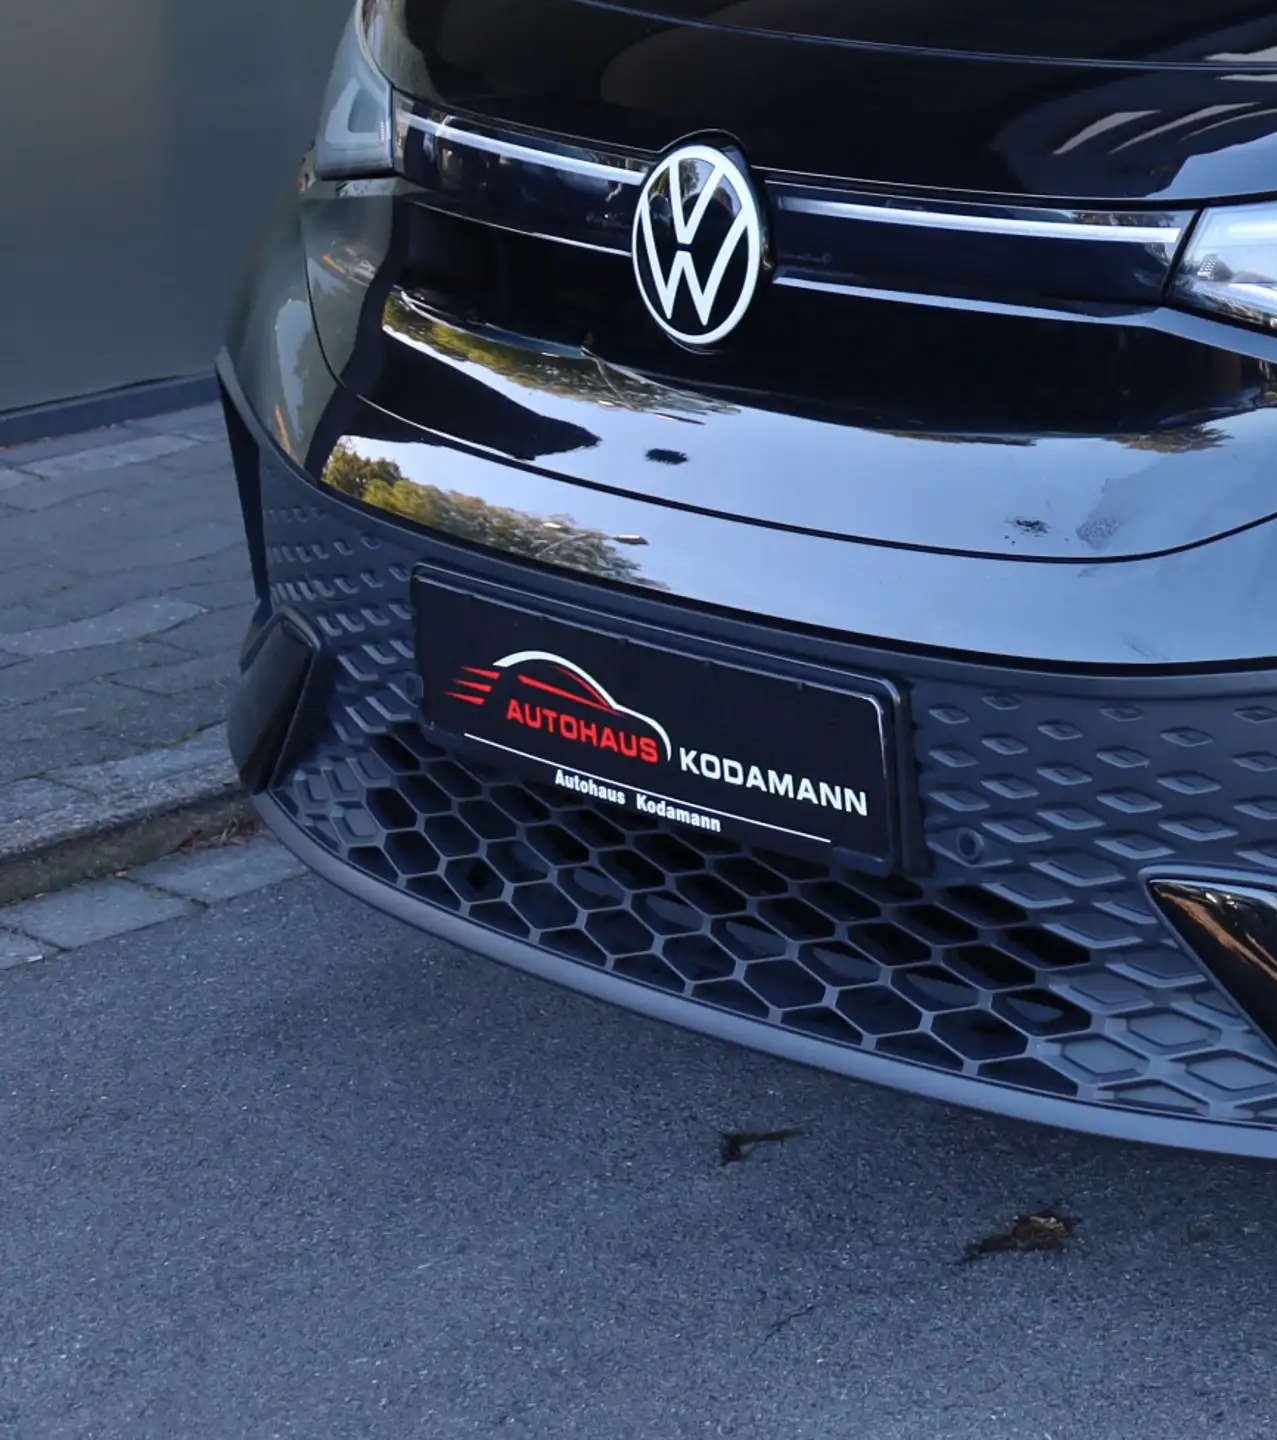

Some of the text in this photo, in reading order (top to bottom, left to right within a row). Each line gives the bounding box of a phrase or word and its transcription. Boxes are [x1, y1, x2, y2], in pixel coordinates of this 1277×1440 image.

[507, 698, 867, 816] AUTOHAUS KODAMANN
[555, 769, 721, 832] Autohaus Kodamann
